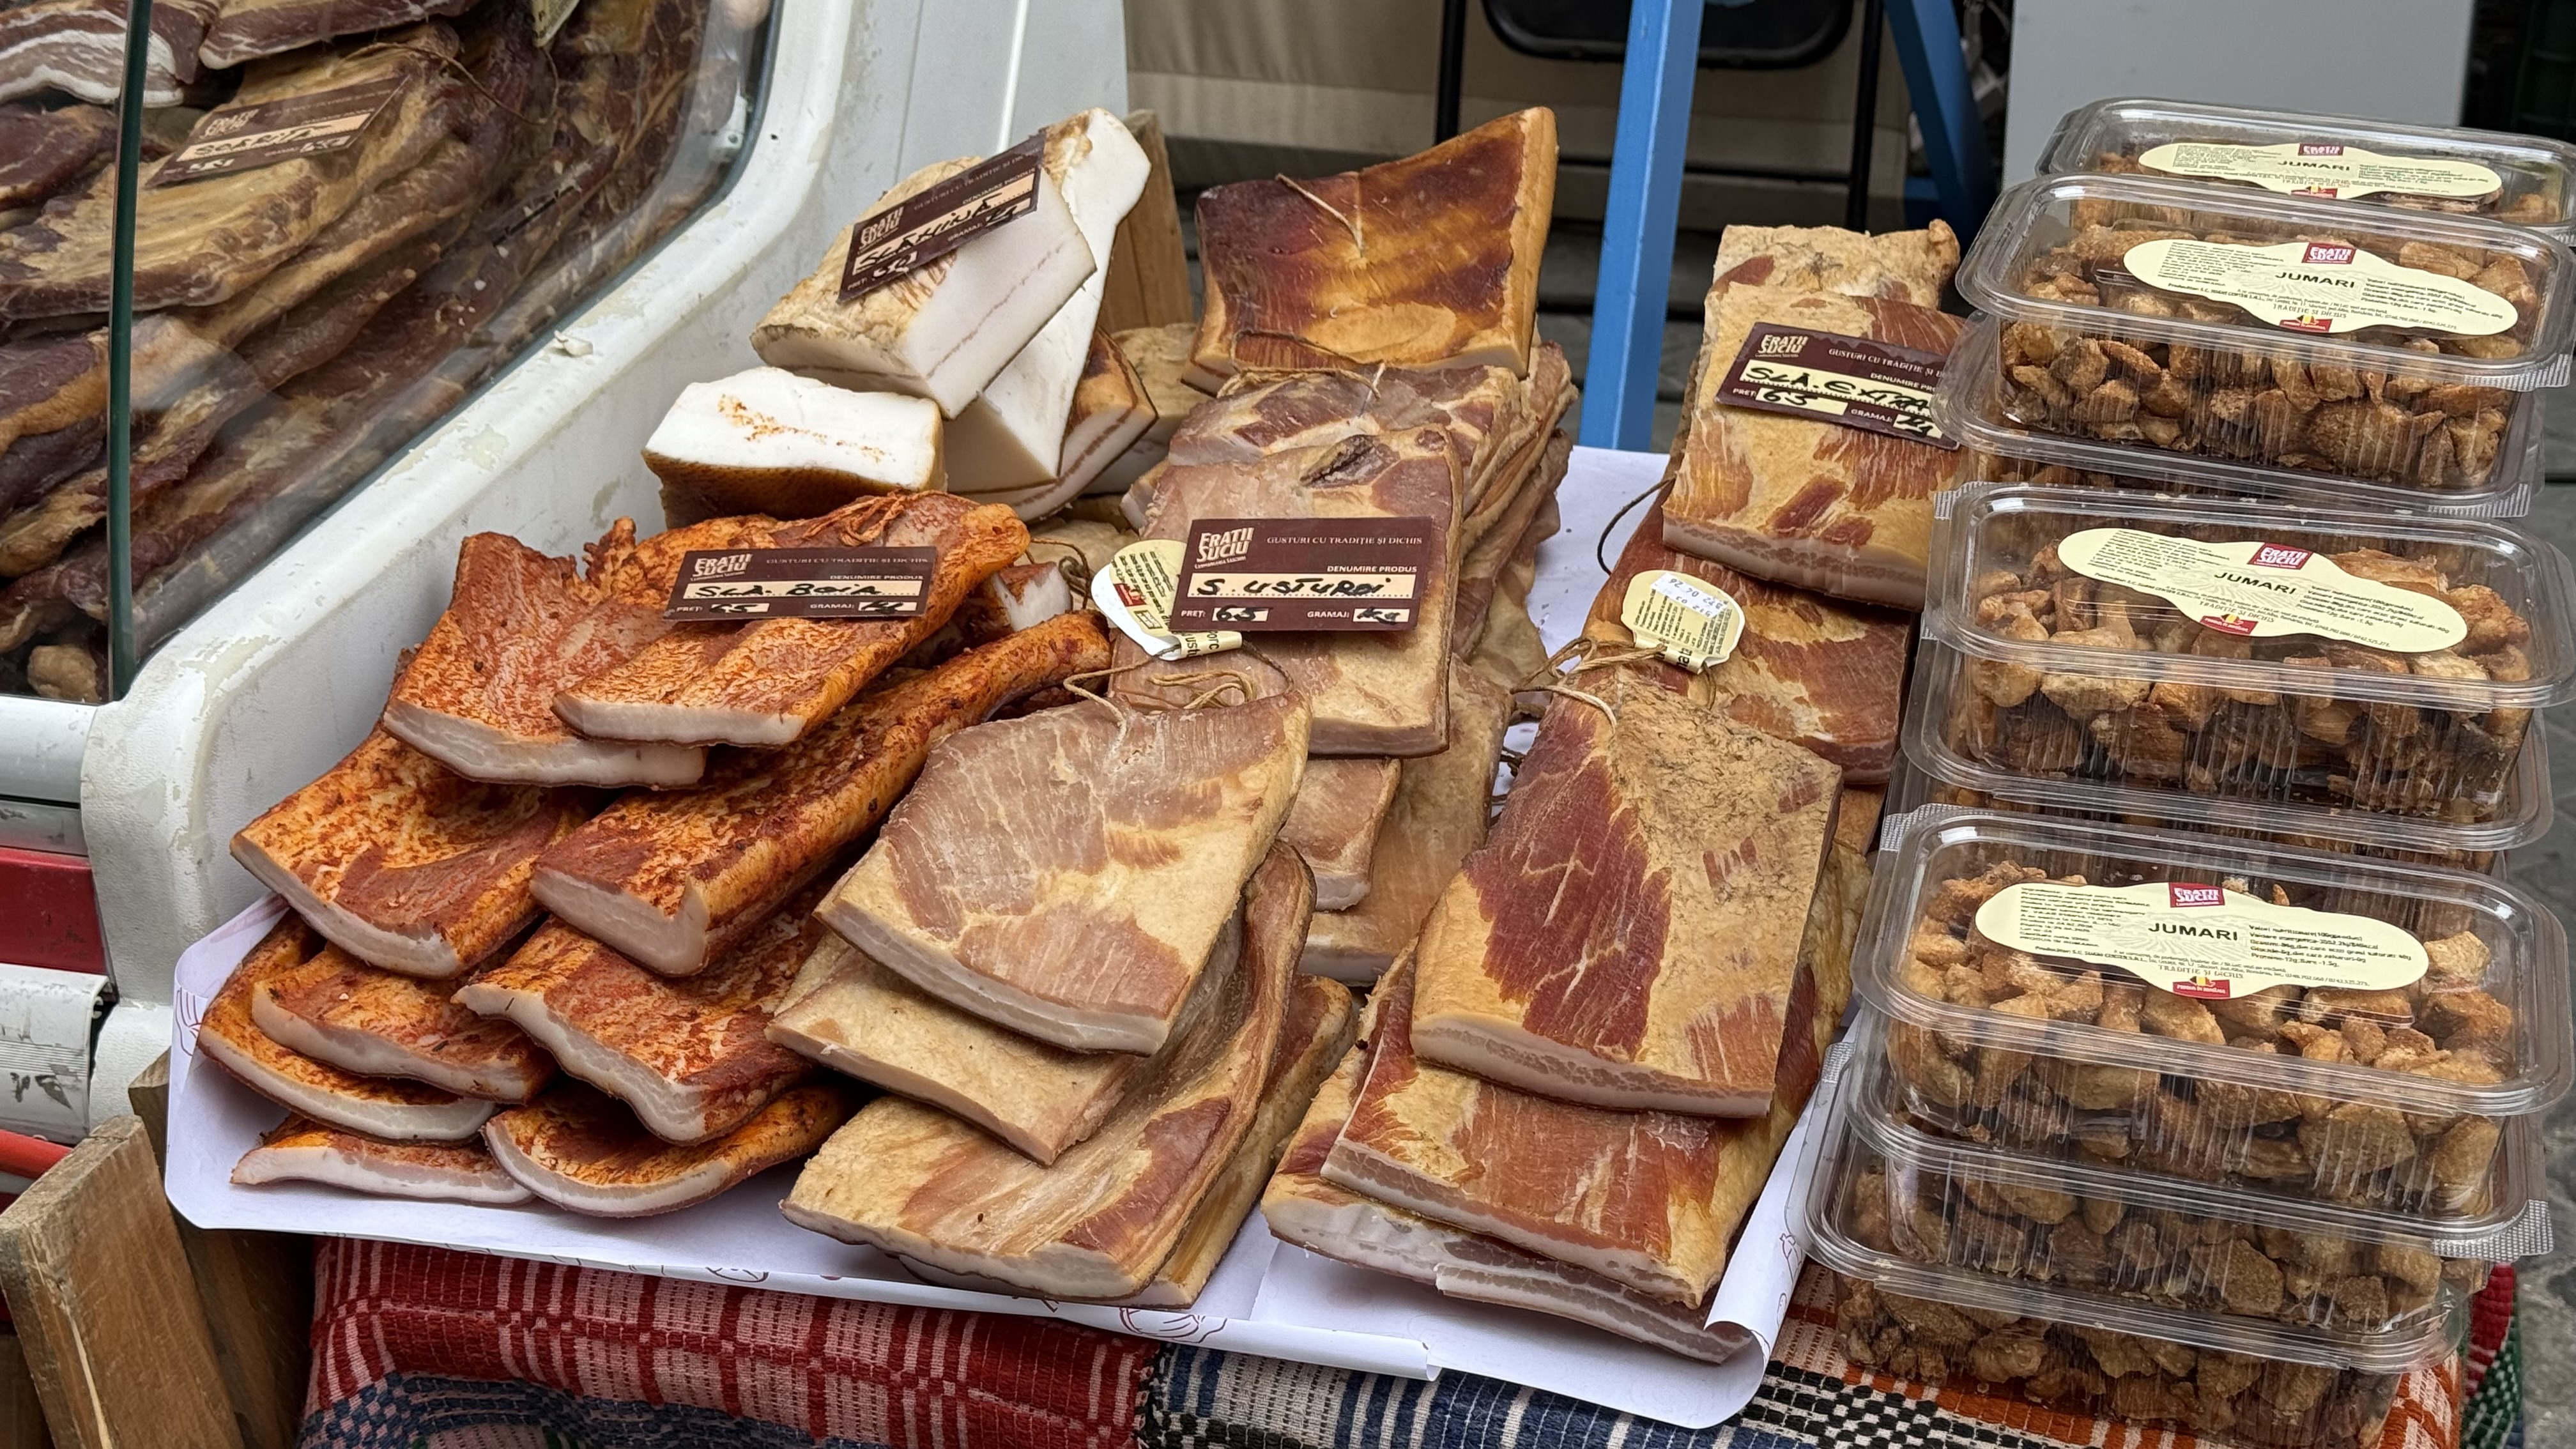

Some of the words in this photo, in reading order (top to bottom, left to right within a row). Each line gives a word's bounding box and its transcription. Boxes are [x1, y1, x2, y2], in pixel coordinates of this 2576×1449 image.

[2277, 161, 2350, 171] JUMARI
[2275, 272, 2355, 288] JUMARI
[1828, 348, 1867, 361] GUSTURI
[1867, 355, 1881, 364] CU
[1870, 372, 1919, 388] DENUMIRE
[1763, 389, 1818, 406] 65
[1196, 540, 1251, 563] SUCIU
[2214, 572, 2297, 595] JUMARI
[1216, 604, 1274, 622] 65
[2148, 923, 2238, 941] JUMARI
